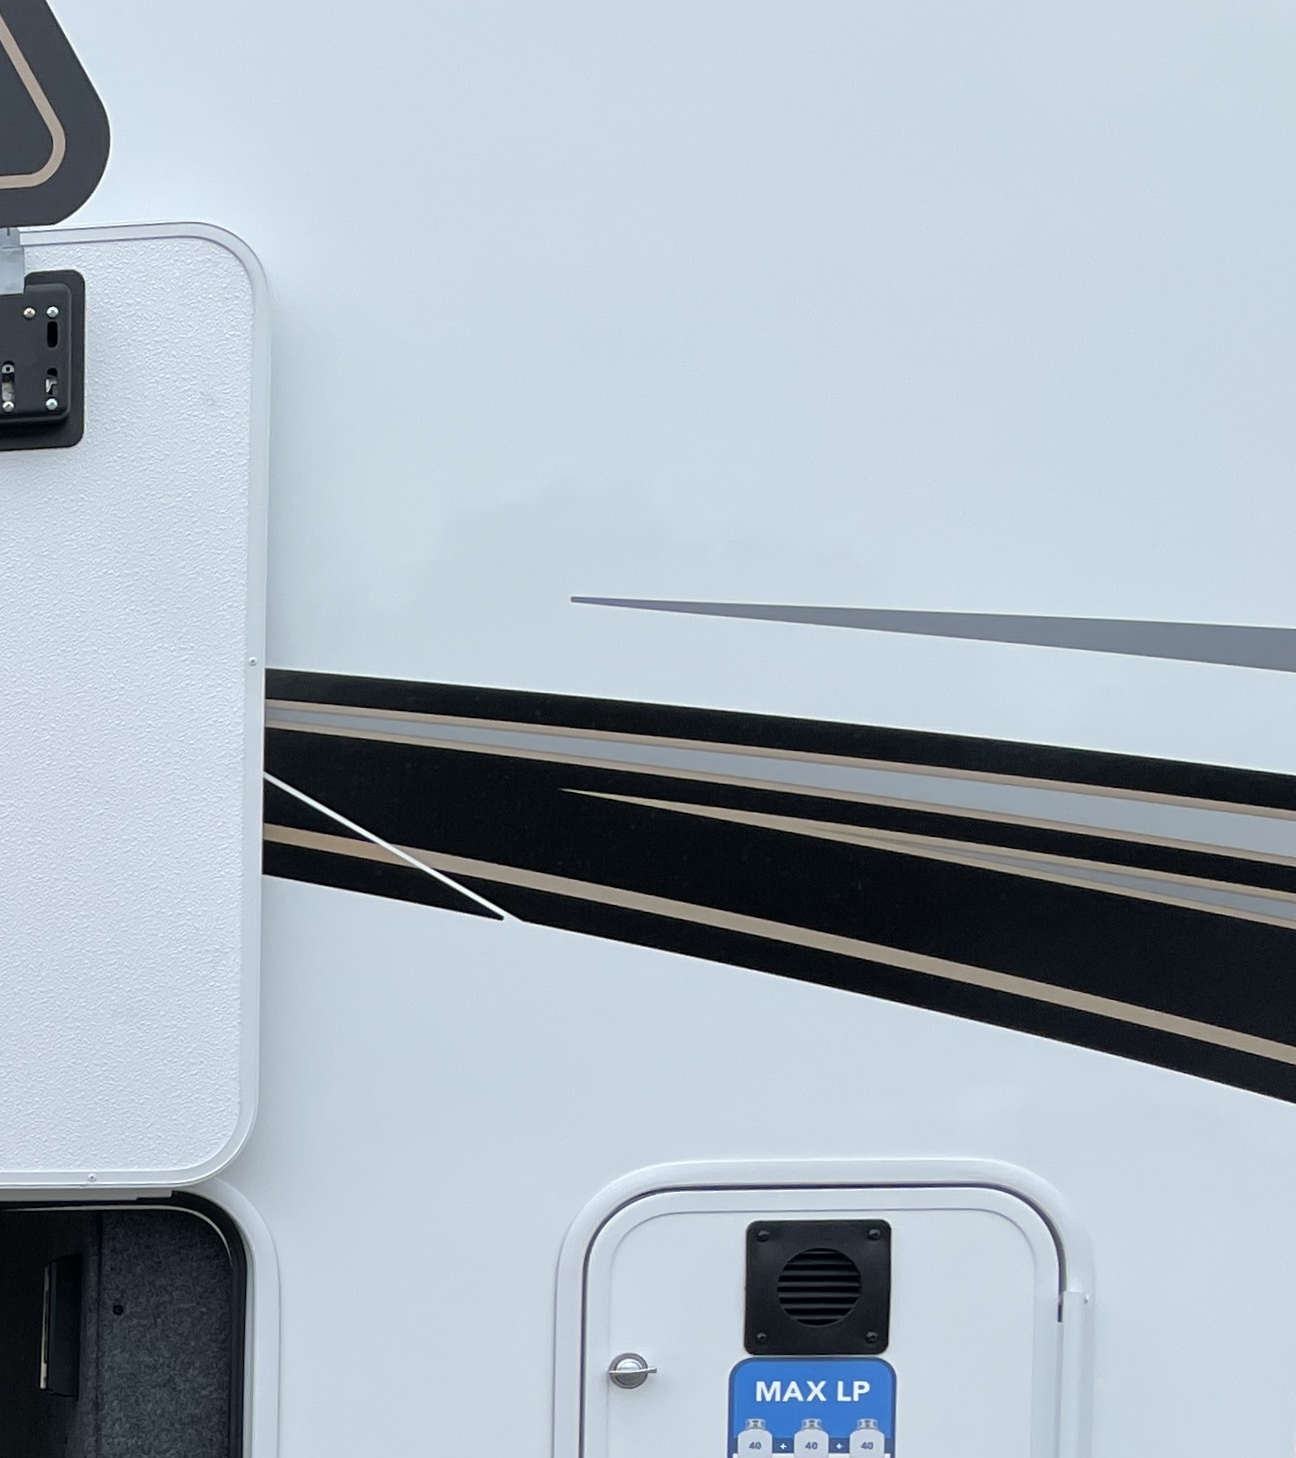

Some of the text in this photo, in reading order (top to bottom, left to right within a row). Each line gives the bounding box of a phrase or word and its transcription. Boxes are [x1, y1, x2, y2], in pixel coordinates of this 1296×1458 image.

[755, 1380, 871, 1402] MAX LP
[748, 1441, 762, 1450] 40
[805, 1441, 818, 1450] 40
[860, 1441, 874, 1450] 40
